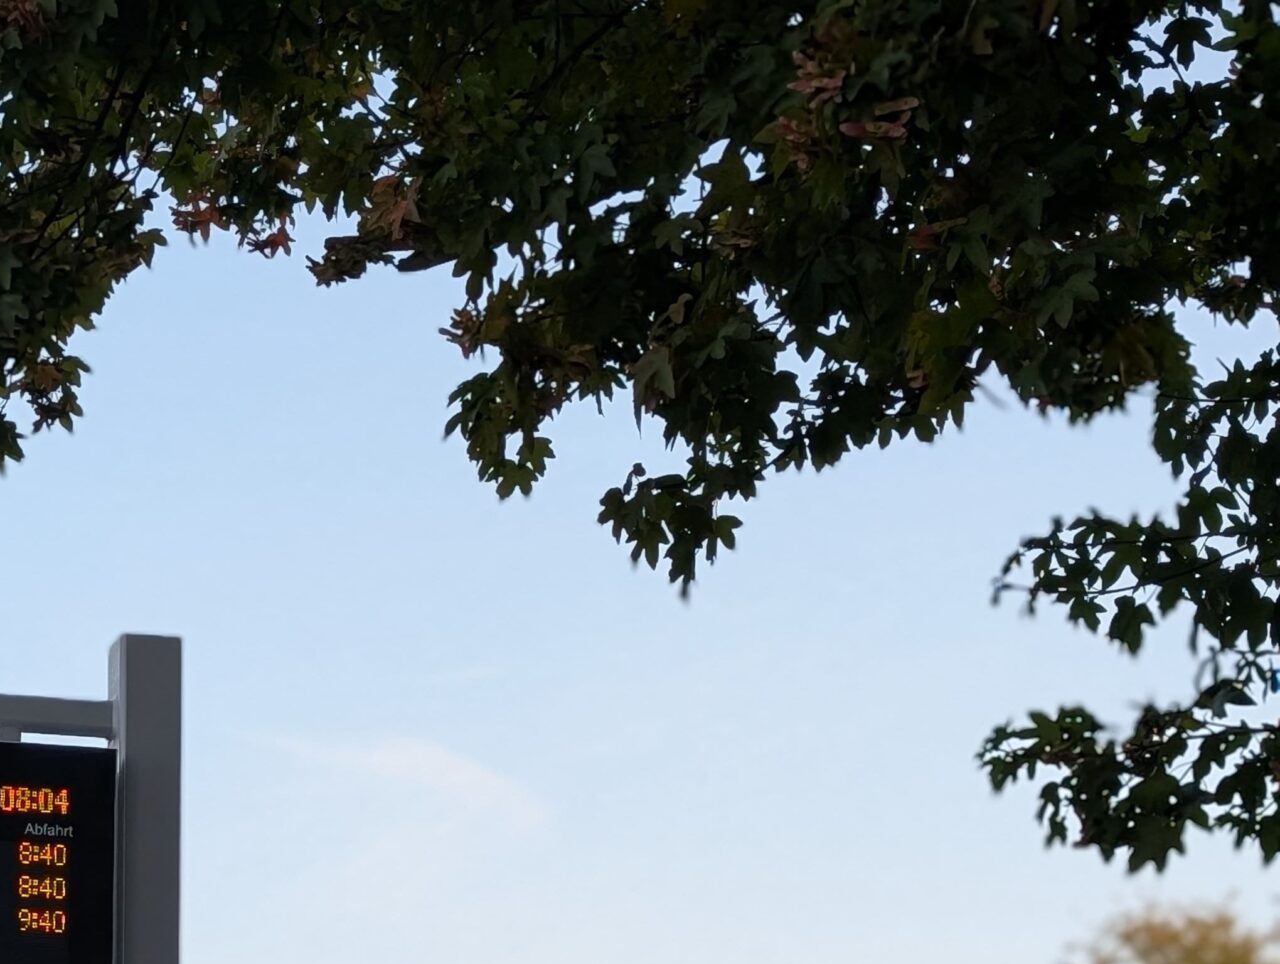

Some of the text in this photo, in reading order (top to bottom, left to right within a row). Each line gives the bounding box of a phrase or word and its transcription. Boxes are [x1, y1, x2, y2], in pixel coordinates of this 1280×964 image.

[0, 786, 69, 814] 08:04
[24, 823, 74, 838] Abfahrt
[19, 842, 66, 866] 8:40
[19, 875, 66, 900] 8:40
[18, 908, 66, 933] 9:40
